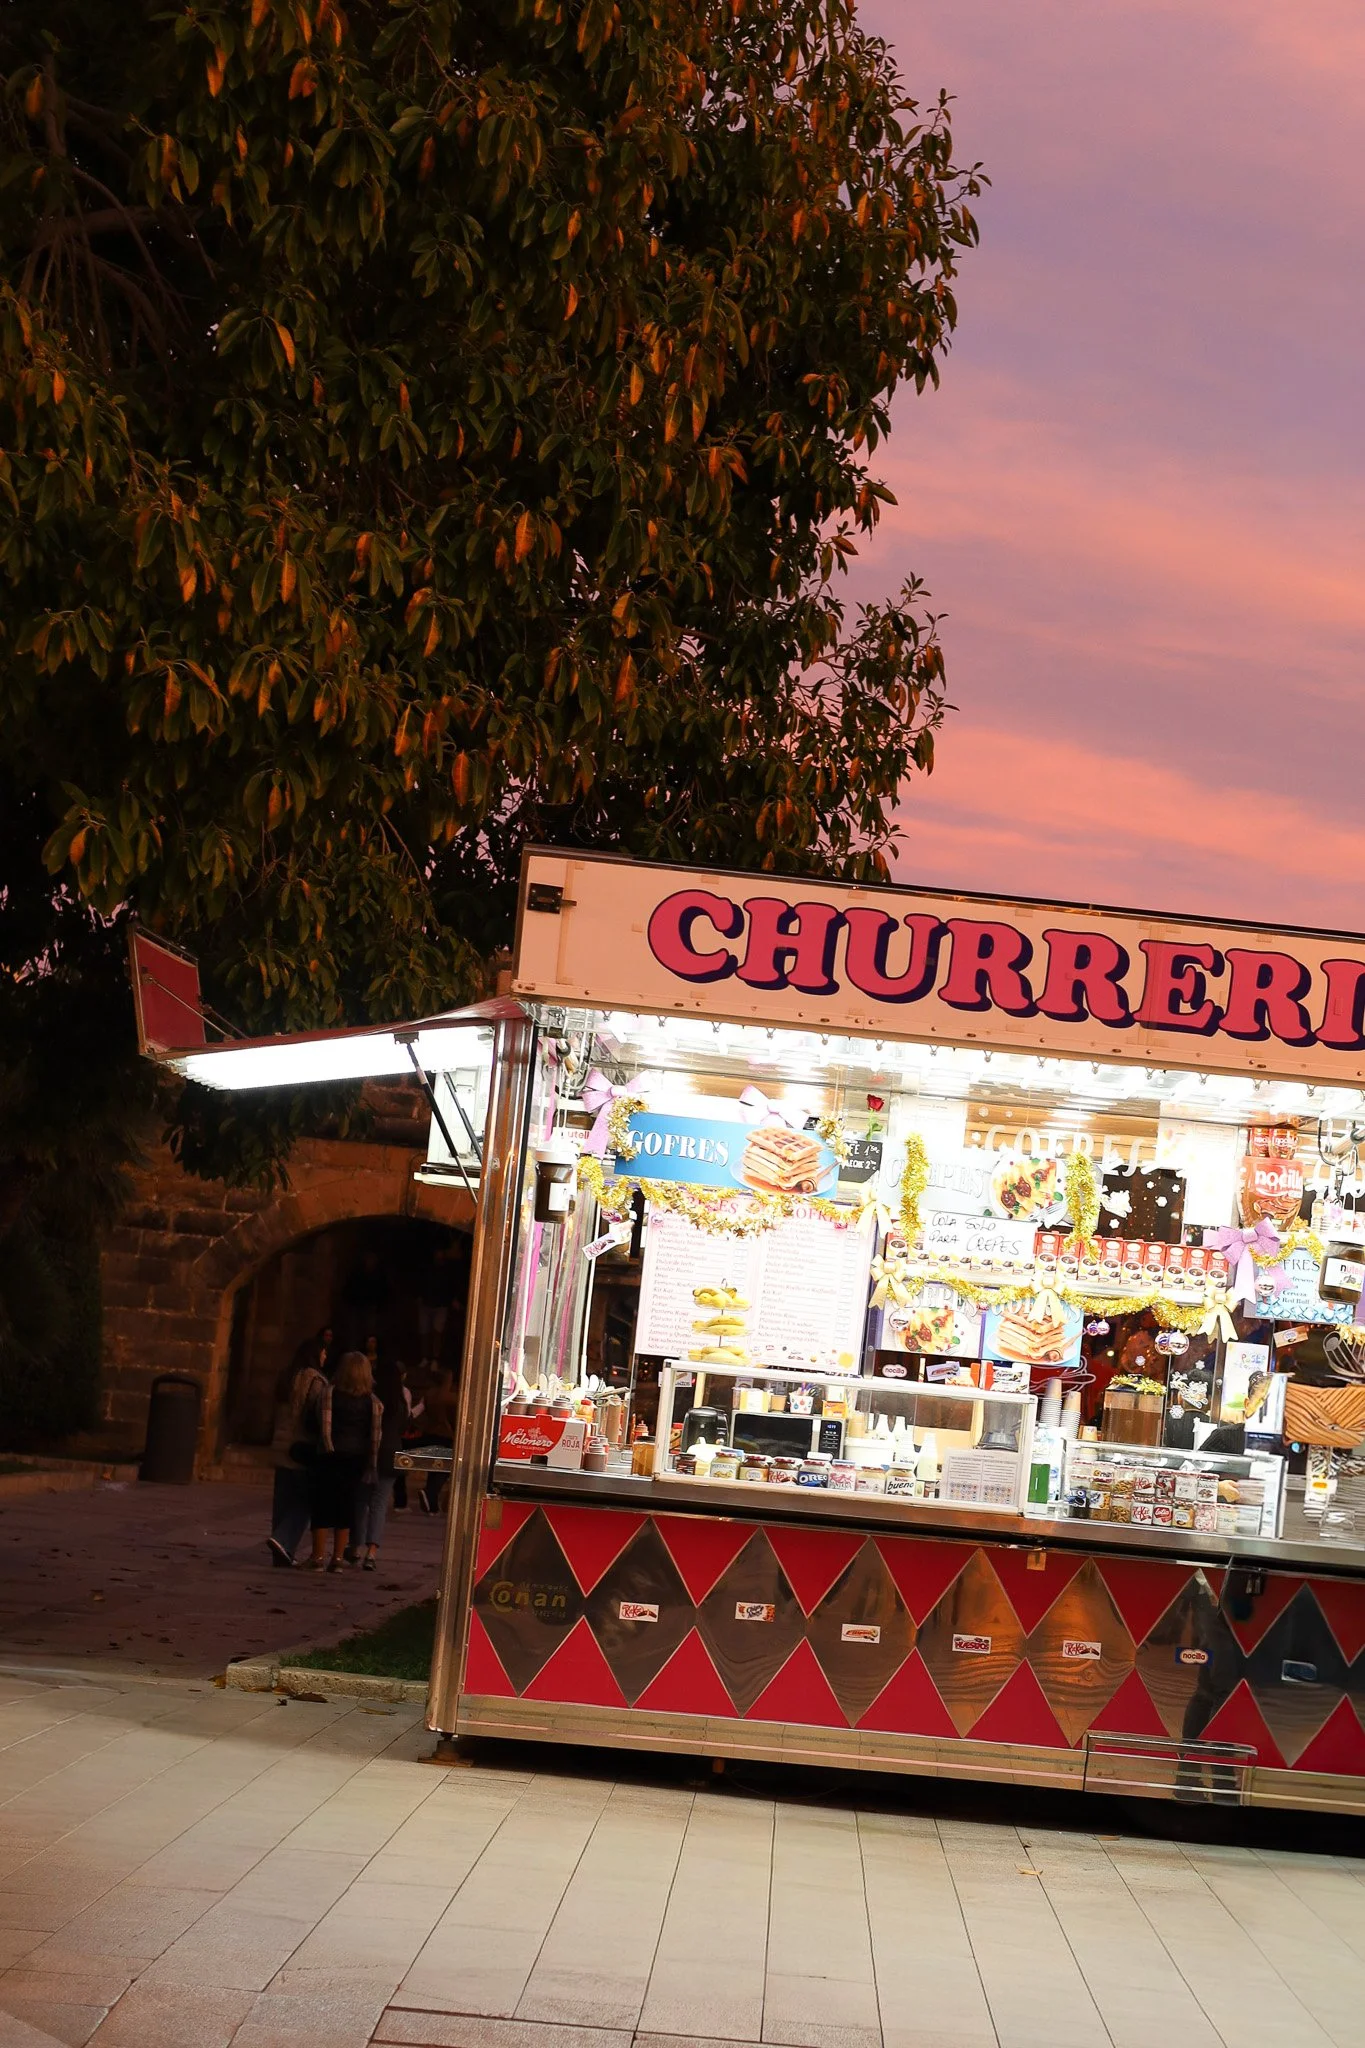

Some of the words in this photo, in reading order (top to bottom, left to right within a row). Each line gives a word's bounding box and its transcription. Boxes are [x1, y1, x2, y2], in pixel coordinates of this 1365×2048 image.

[1255, 1166, 1303, 1191] nocill
[931, 1211, 957, 1227] COLA
[965, 1217, 996, 1231] SOLO
[966, 1233, 1023, 1255] CREPES
[884, 1366, 905, 1375] nocilla
[501, 1431, 555, 1447] Melonero
[516, 1428, 525, 1436] El
[887, 1482, 914, 1490] bueno
[489, 1579, 567, 1613] Conan
[1182, 1652, 1206, 1661] nocilla
